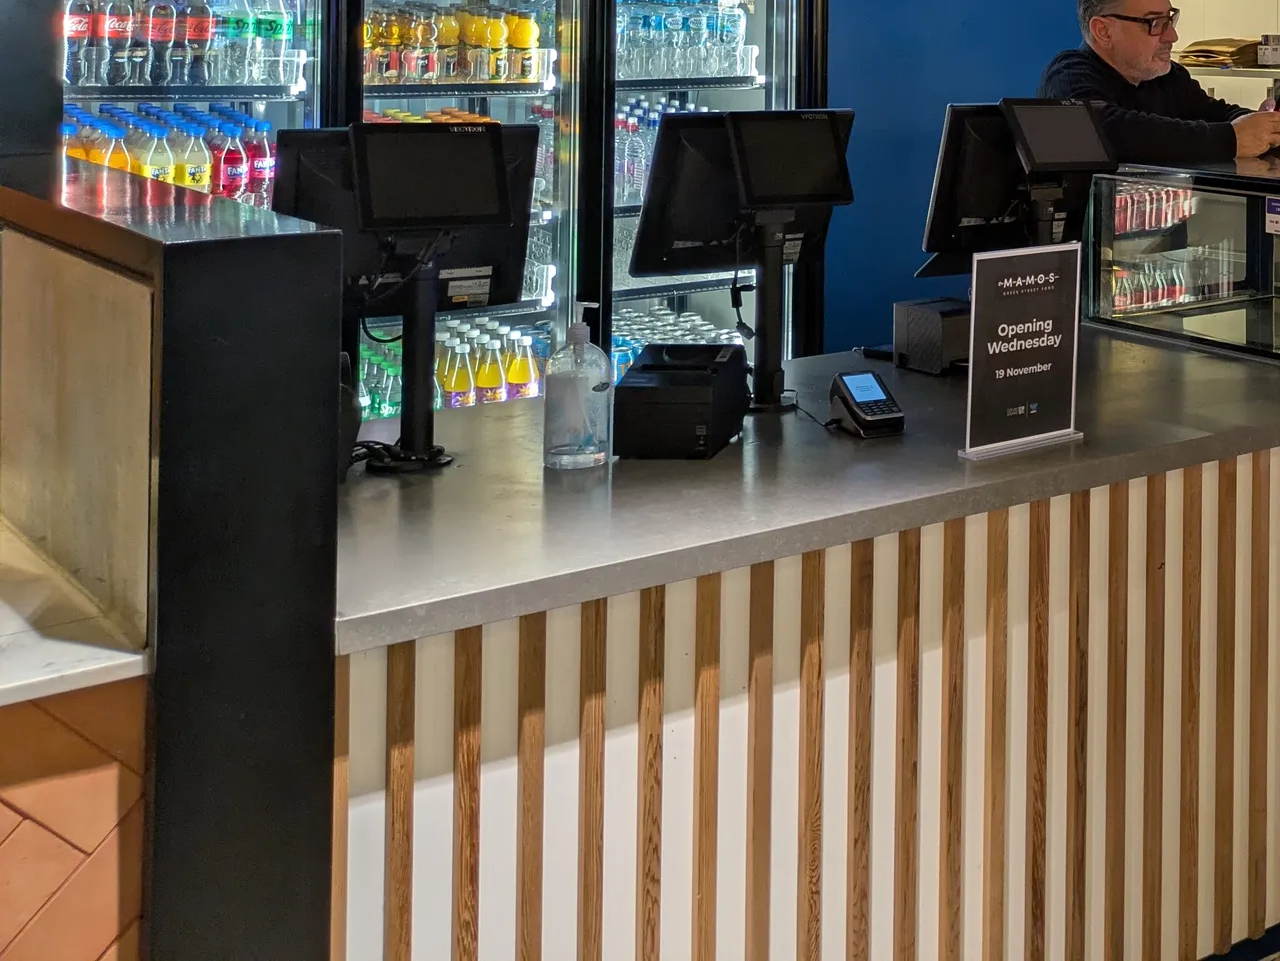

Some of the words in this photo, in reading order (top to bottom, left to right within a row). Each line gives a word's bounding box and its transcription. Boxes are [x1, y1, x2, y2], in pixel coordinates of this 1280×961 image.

[998, 319, 1053, 338] Opening
[987, 334, 1062, 354] Wednesday
[995, 369, 1004, 379] 19
[1007, 363, 1052, 377] November
